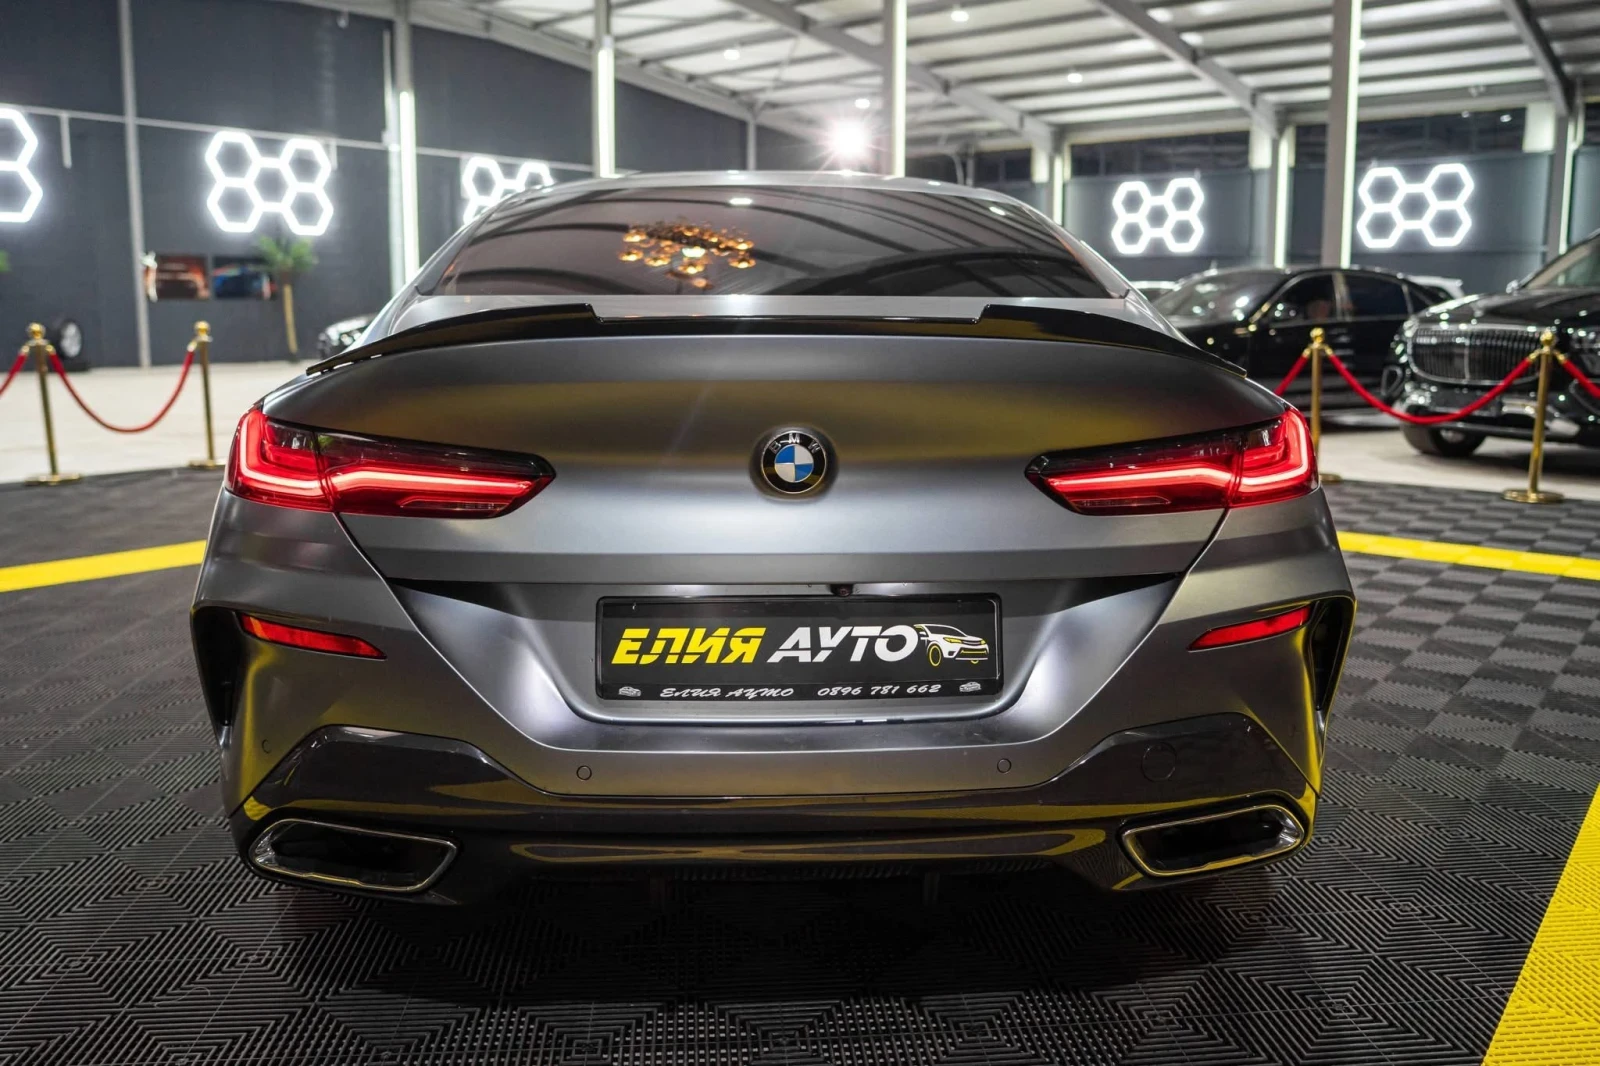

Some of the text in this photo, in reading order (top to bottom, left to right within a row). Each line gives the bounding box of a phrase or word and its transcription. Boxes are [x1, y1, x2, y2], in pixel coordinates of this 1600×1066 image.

[768, 432, 821, 454] BMW
[612, 624, 919, 665] ЕЛИЯ АУТО
[817, 685, 862, 697] 0896
[870, 684, 900, 696] 781
[906, 683, 942, 695] 662
